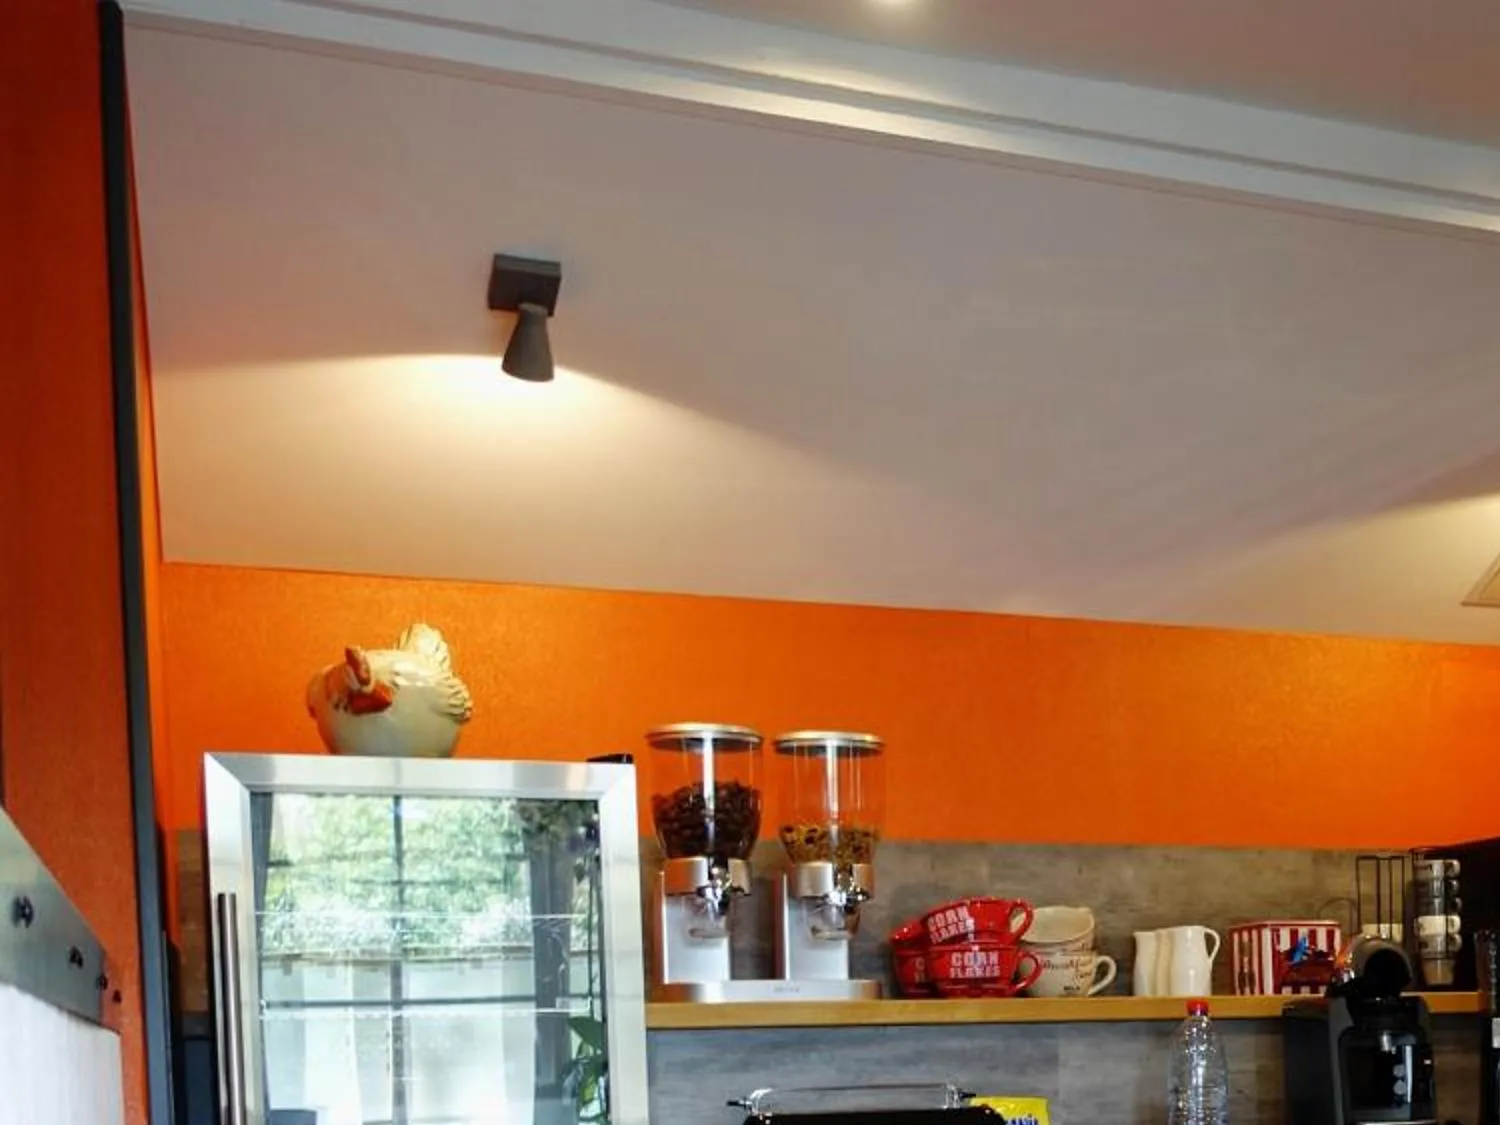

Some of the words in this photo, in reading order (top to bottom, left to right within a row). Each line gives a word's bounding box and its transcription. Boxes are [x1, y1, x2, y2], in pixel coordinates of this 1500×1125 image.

[927, 905, 971, 931] CORN
[950, 951, 1000, 967] CORN
[949, 966, 1001, 979] FLAKES
